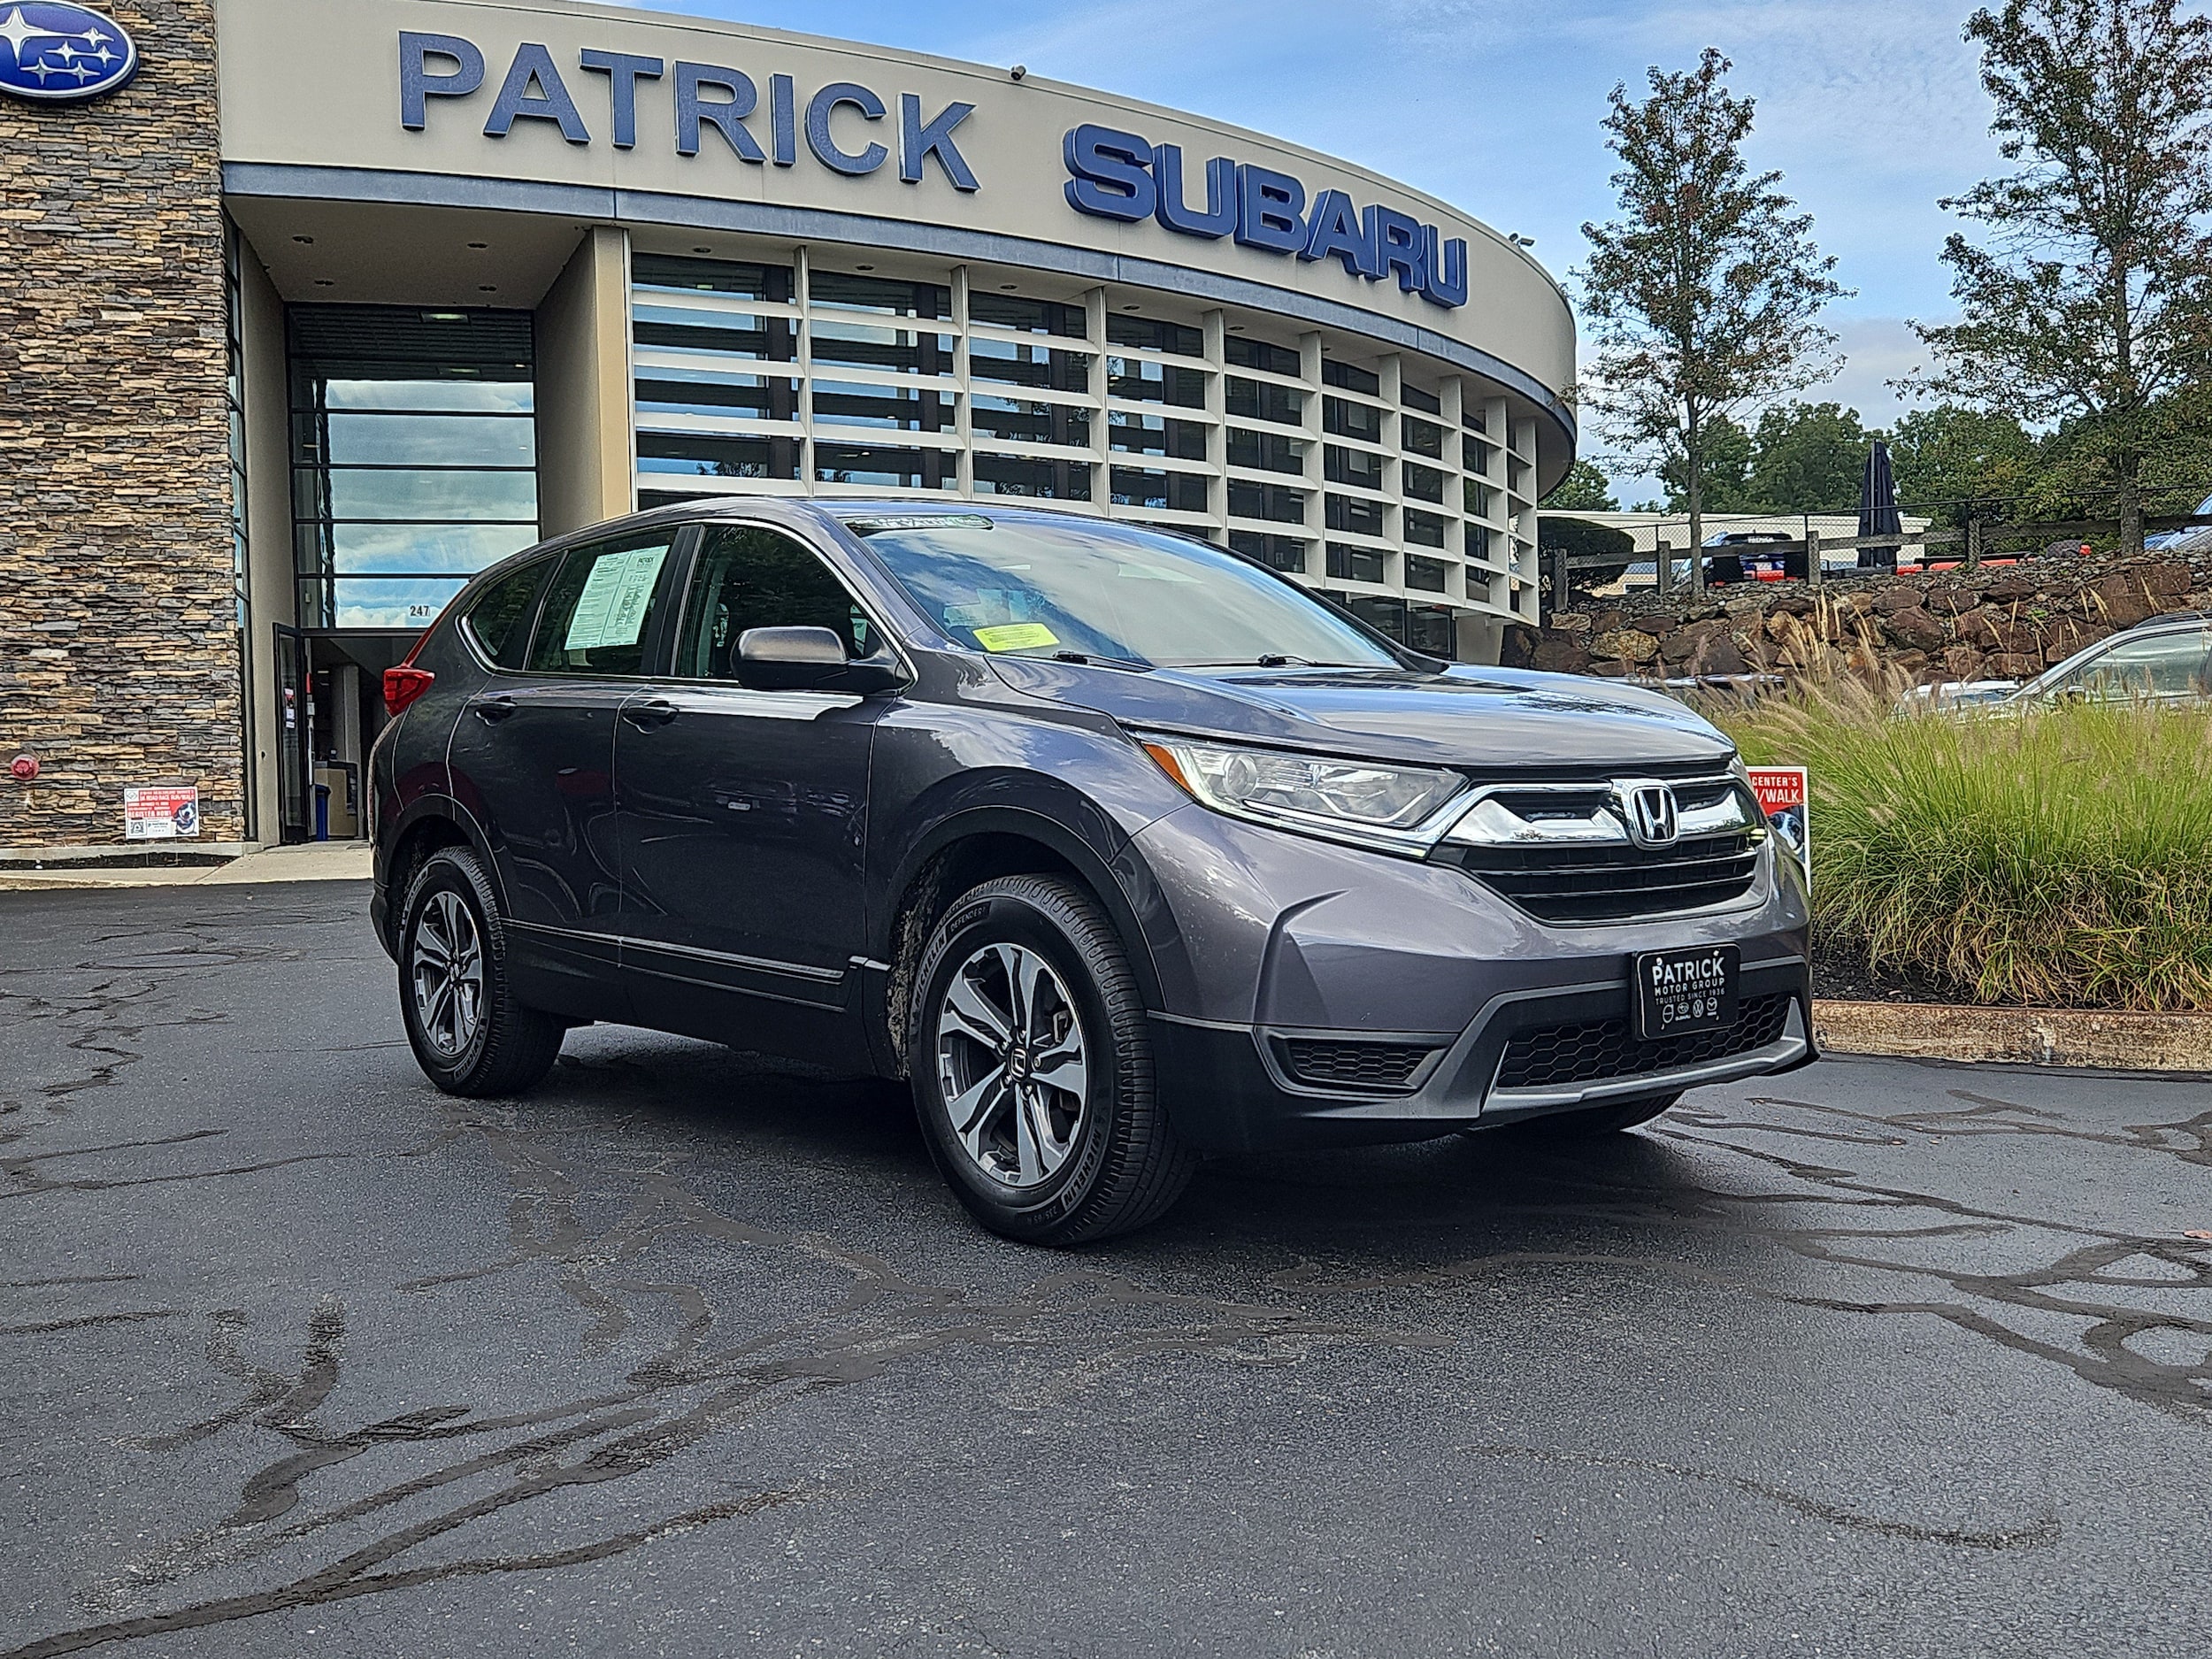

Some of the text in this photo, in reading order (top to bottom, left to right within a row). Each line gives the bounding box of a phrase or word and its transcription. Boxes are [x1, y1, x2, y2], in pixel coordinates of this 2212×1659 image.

[398, 29, 1469, 309] PATRICK SUBARU
[410, 605, 430, 617] 247
[1752, 776, 1798, 787] CENTER'S
[1652, 956, 1725, 986] PATRICK
[1654, 977, 1725, 996] MOTOR GROUP
[1655, 987, 1725, 1006] TRUSTED SINCE 1936
[1064, 1128, 1102, 1205] MICHELIN
